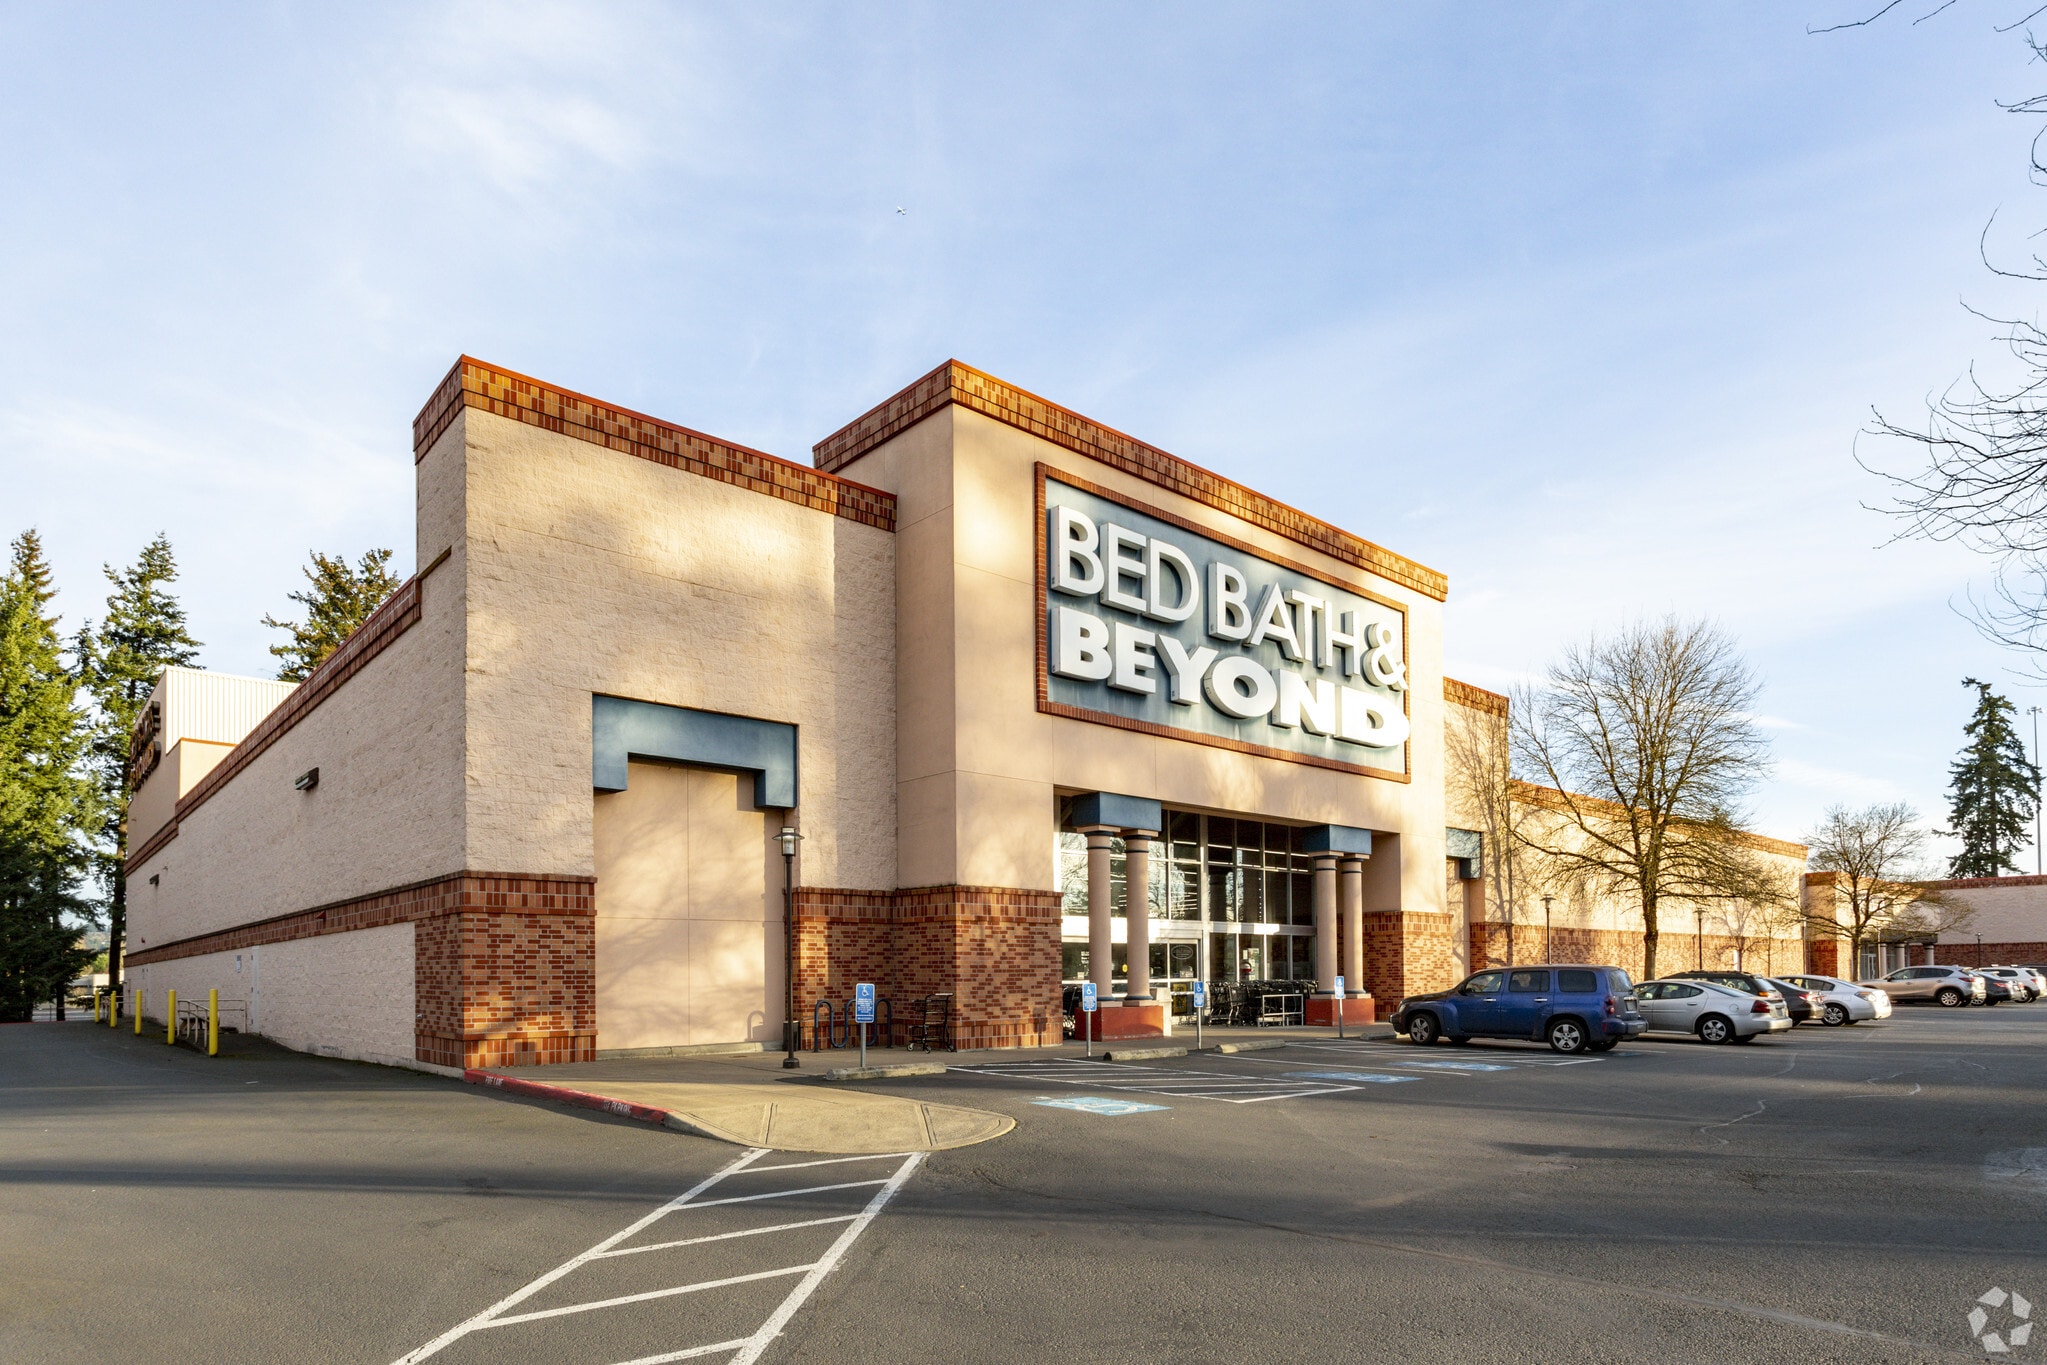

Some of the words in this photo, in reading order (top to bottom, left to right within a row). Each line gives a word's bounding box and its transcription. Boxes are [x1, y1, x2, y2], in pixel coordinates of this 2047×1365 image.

[1051, 505, 1199, 623] BED
[1209, 562, 1360, 677] BATH
[1364, 622, 1408, 691] &
[1051, 606, 1410, 748] BEYOND
